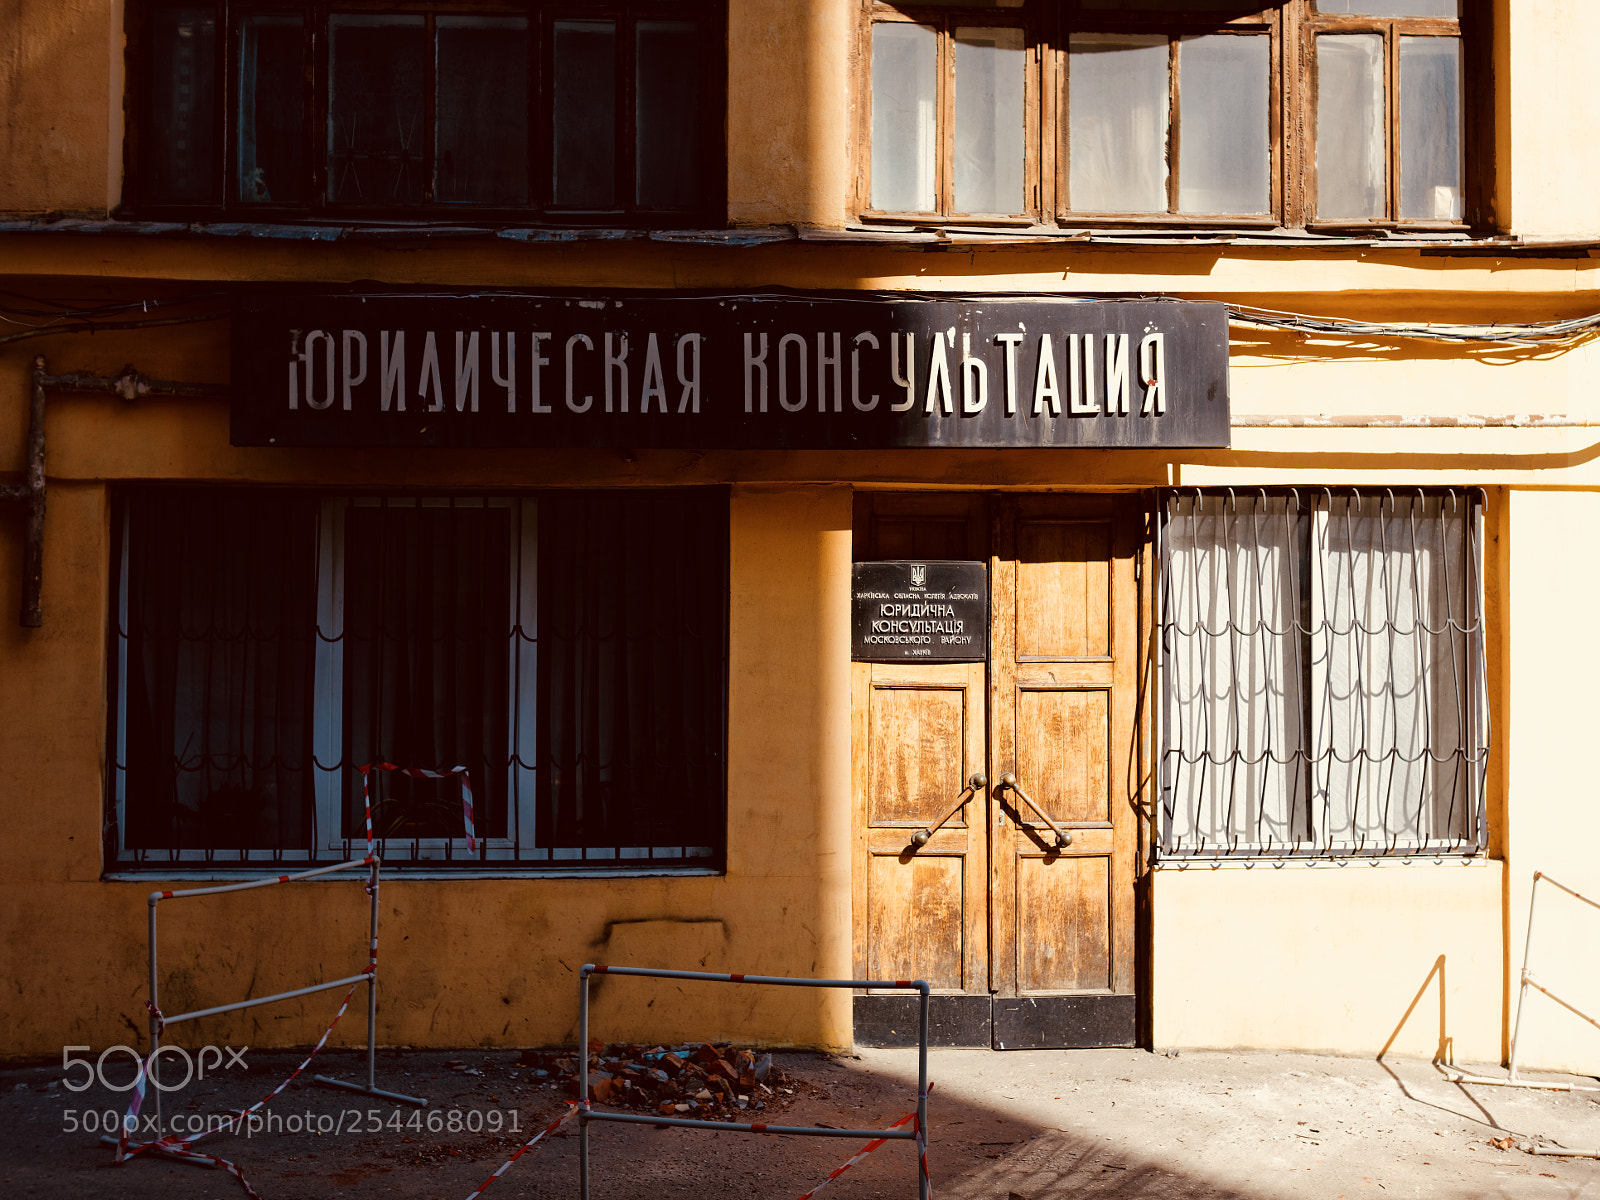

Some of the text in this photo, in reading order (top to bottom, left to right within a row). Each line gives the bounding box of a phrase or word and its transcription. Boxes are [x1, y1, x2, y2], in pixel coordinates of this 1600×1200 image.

[744, 331, 1166, 414] КОНСУЛЬТАЦИЯ
[880, 603, 955, 618] ЮРИДИЧНА
[871, 619, 964, 634] КОНСУЛЬТАЦІЯ
[864, 635, 972, 645] МОСКОВСЬКОГО РАЙОНУ
